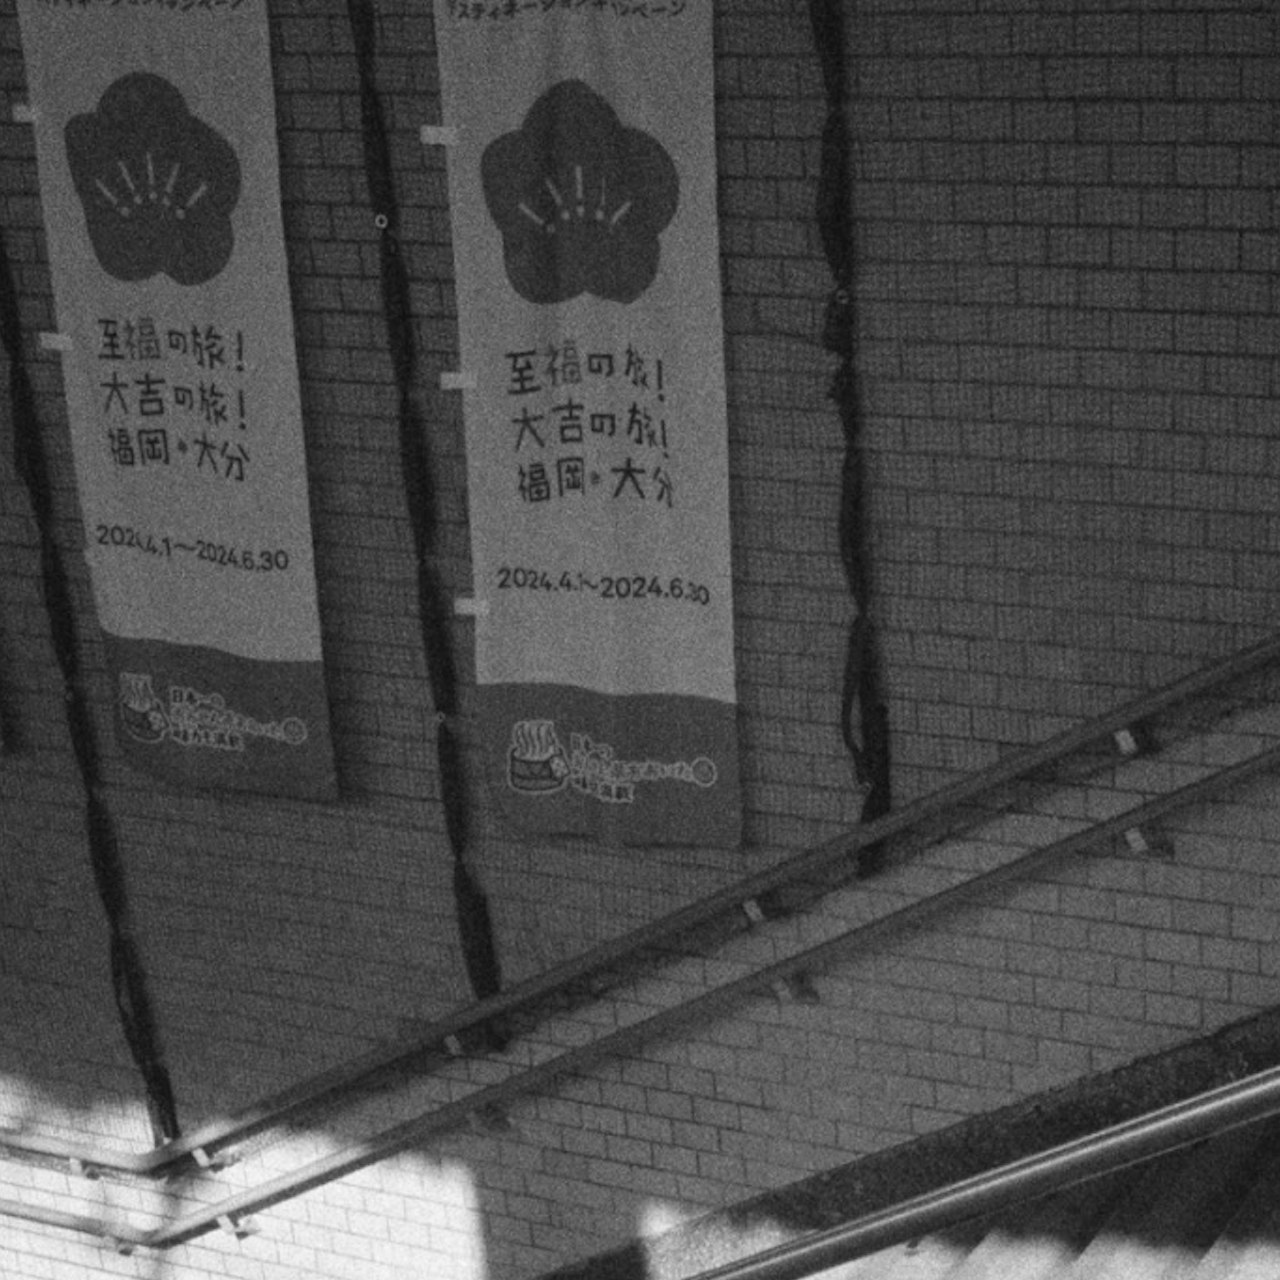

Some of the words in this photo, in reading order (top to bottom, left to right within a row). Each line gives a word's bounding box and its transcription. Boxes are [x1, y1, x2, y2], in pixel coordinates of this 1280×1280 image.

[98, 317, 245, 373] 至福の旅!
[100, 371, 247, 431] 大吉の旅!
